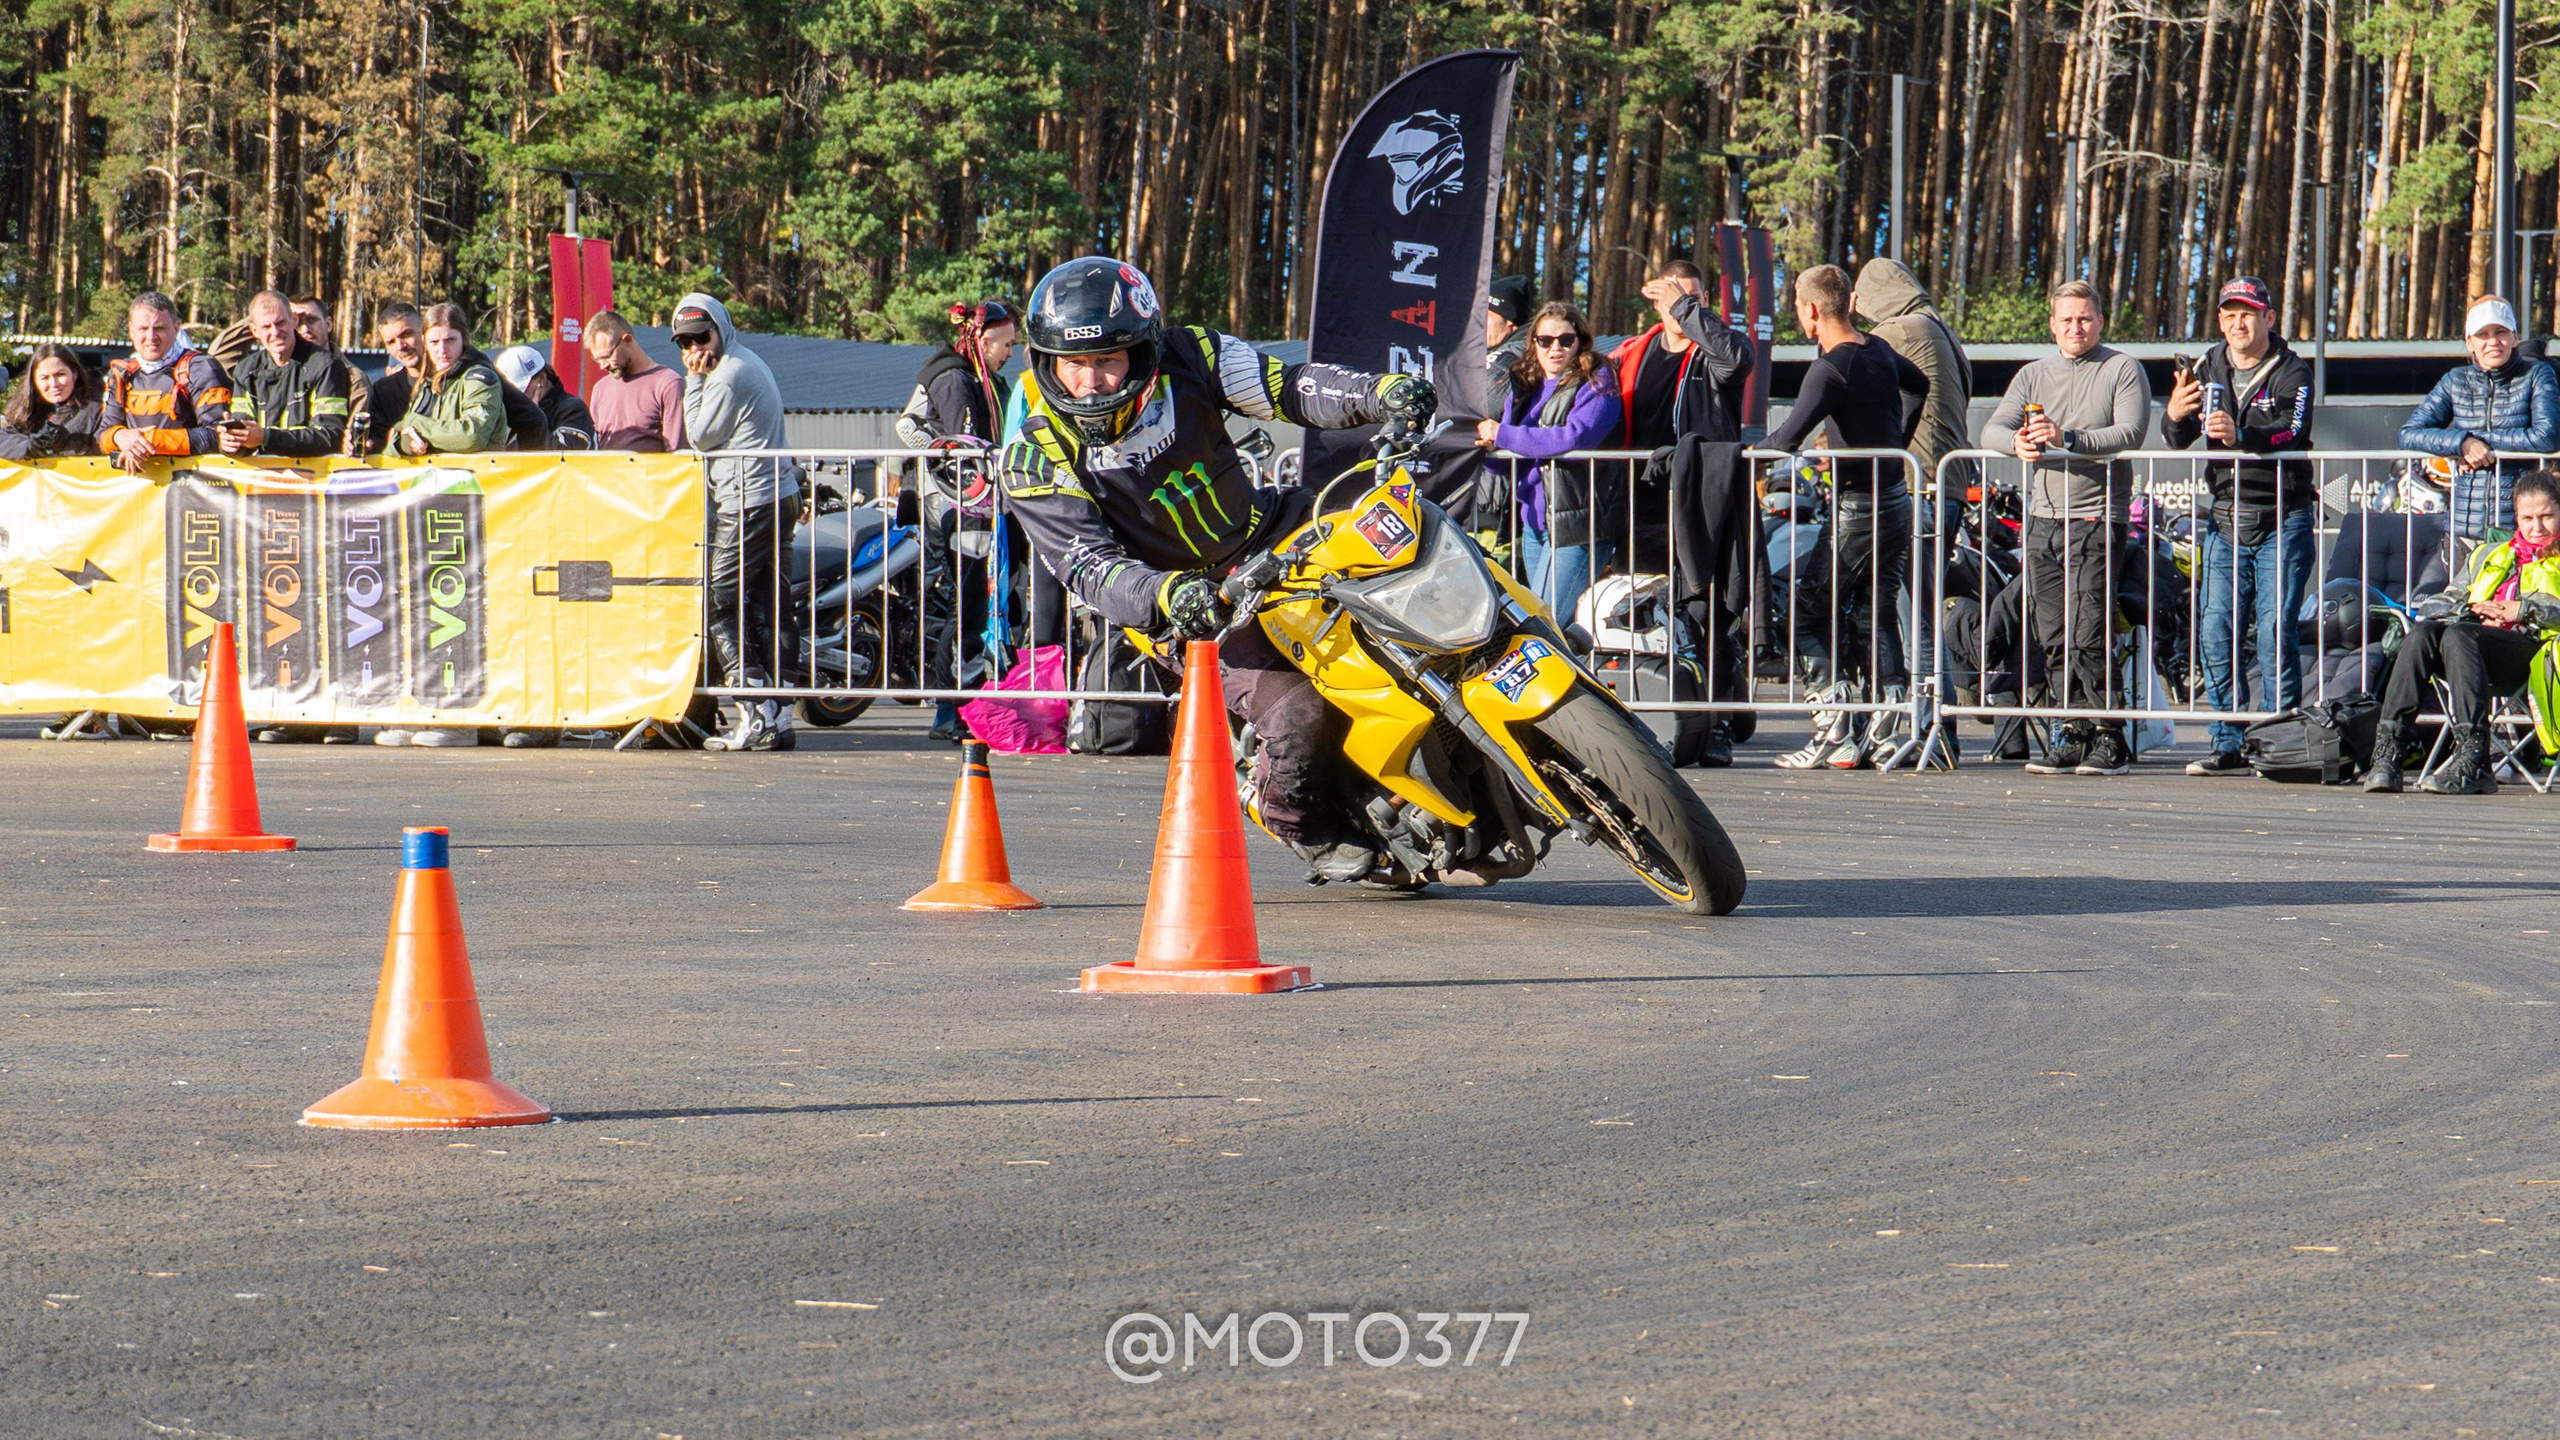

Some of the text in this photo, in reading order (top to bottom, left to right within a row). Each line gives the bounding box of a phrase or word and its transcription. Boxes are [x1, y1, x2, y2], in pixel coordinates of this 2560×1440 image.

[185, 510, 221, 648] VOLT
[264, 508, 301, 648] VOLT
[346, 509, 384, 648] VOLT
[426, 509, 466, 649] VOLT
[1376, 513, 1404, 540] 18
